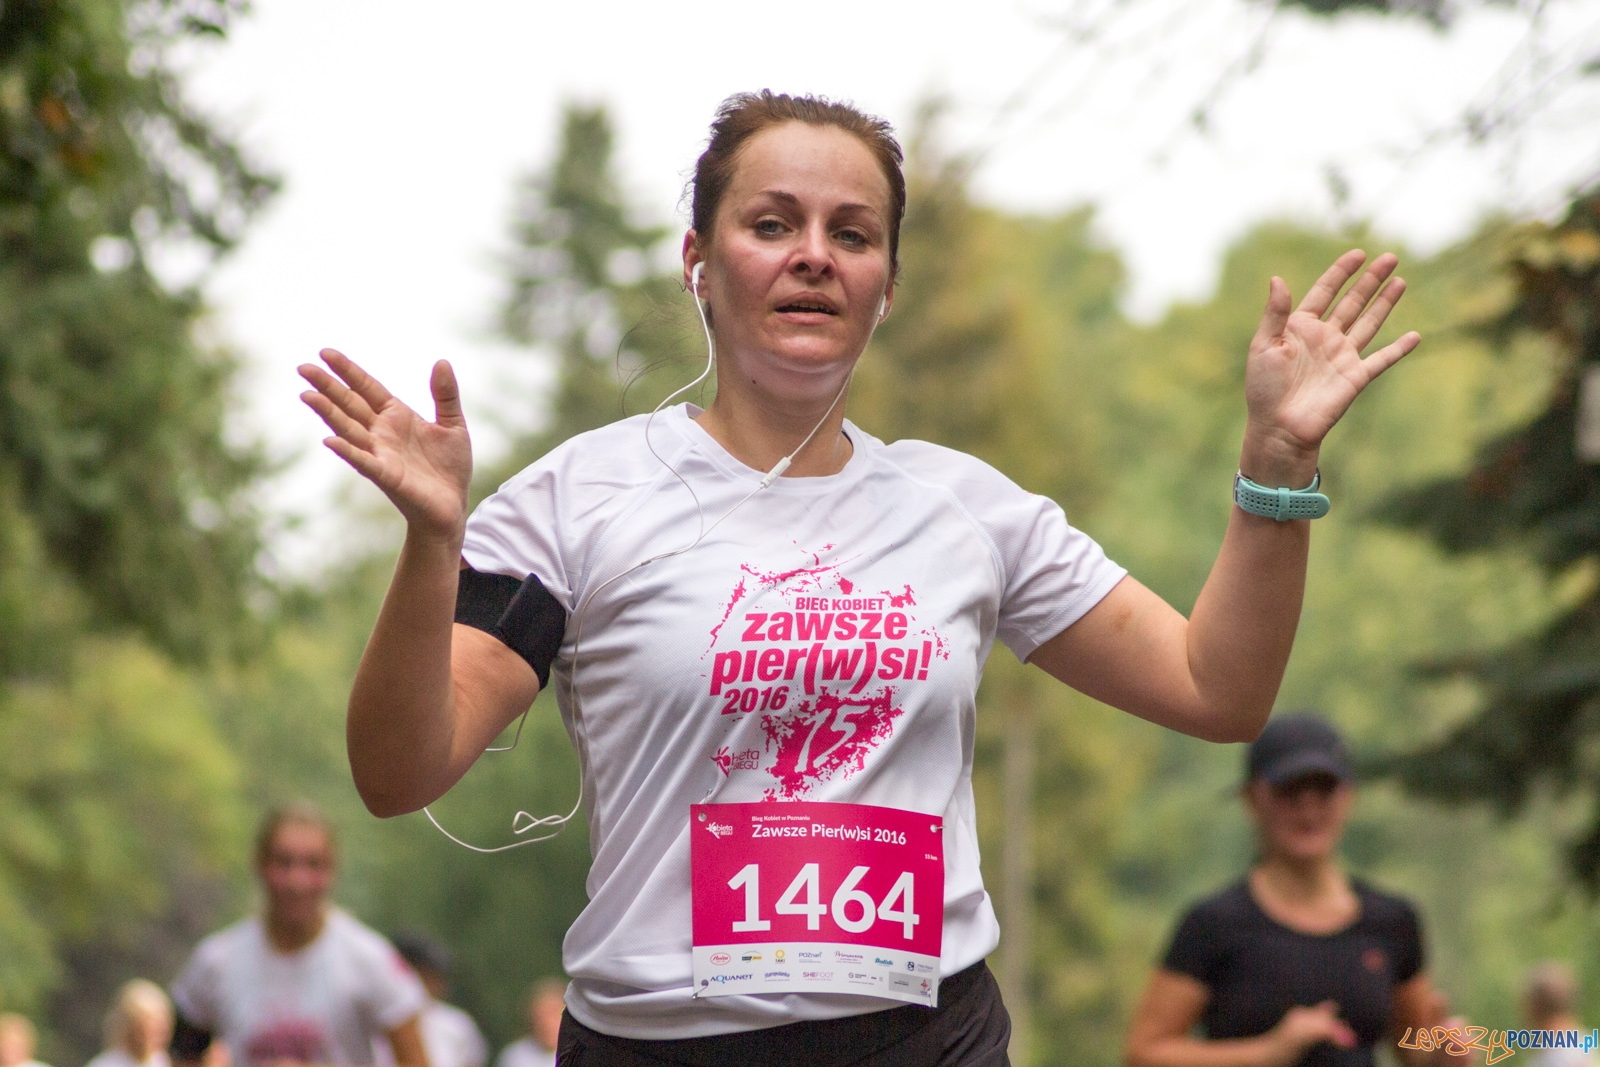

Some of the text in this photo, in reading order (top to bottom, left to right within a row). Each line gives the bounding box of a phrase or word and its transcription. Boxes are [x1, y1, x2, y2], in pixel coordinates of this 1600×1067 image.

[795, 597, 885, 611] BIEG KOBIET
[741, 611, 908, 642] zawsze
[709, 640, 932, 696] pier(w)si!
[721, 686, 790, 715] 2016
[752, 824, 907, 845] Zawsze Pier(w)si 2016
[727, 863, 920, 940] 1464
